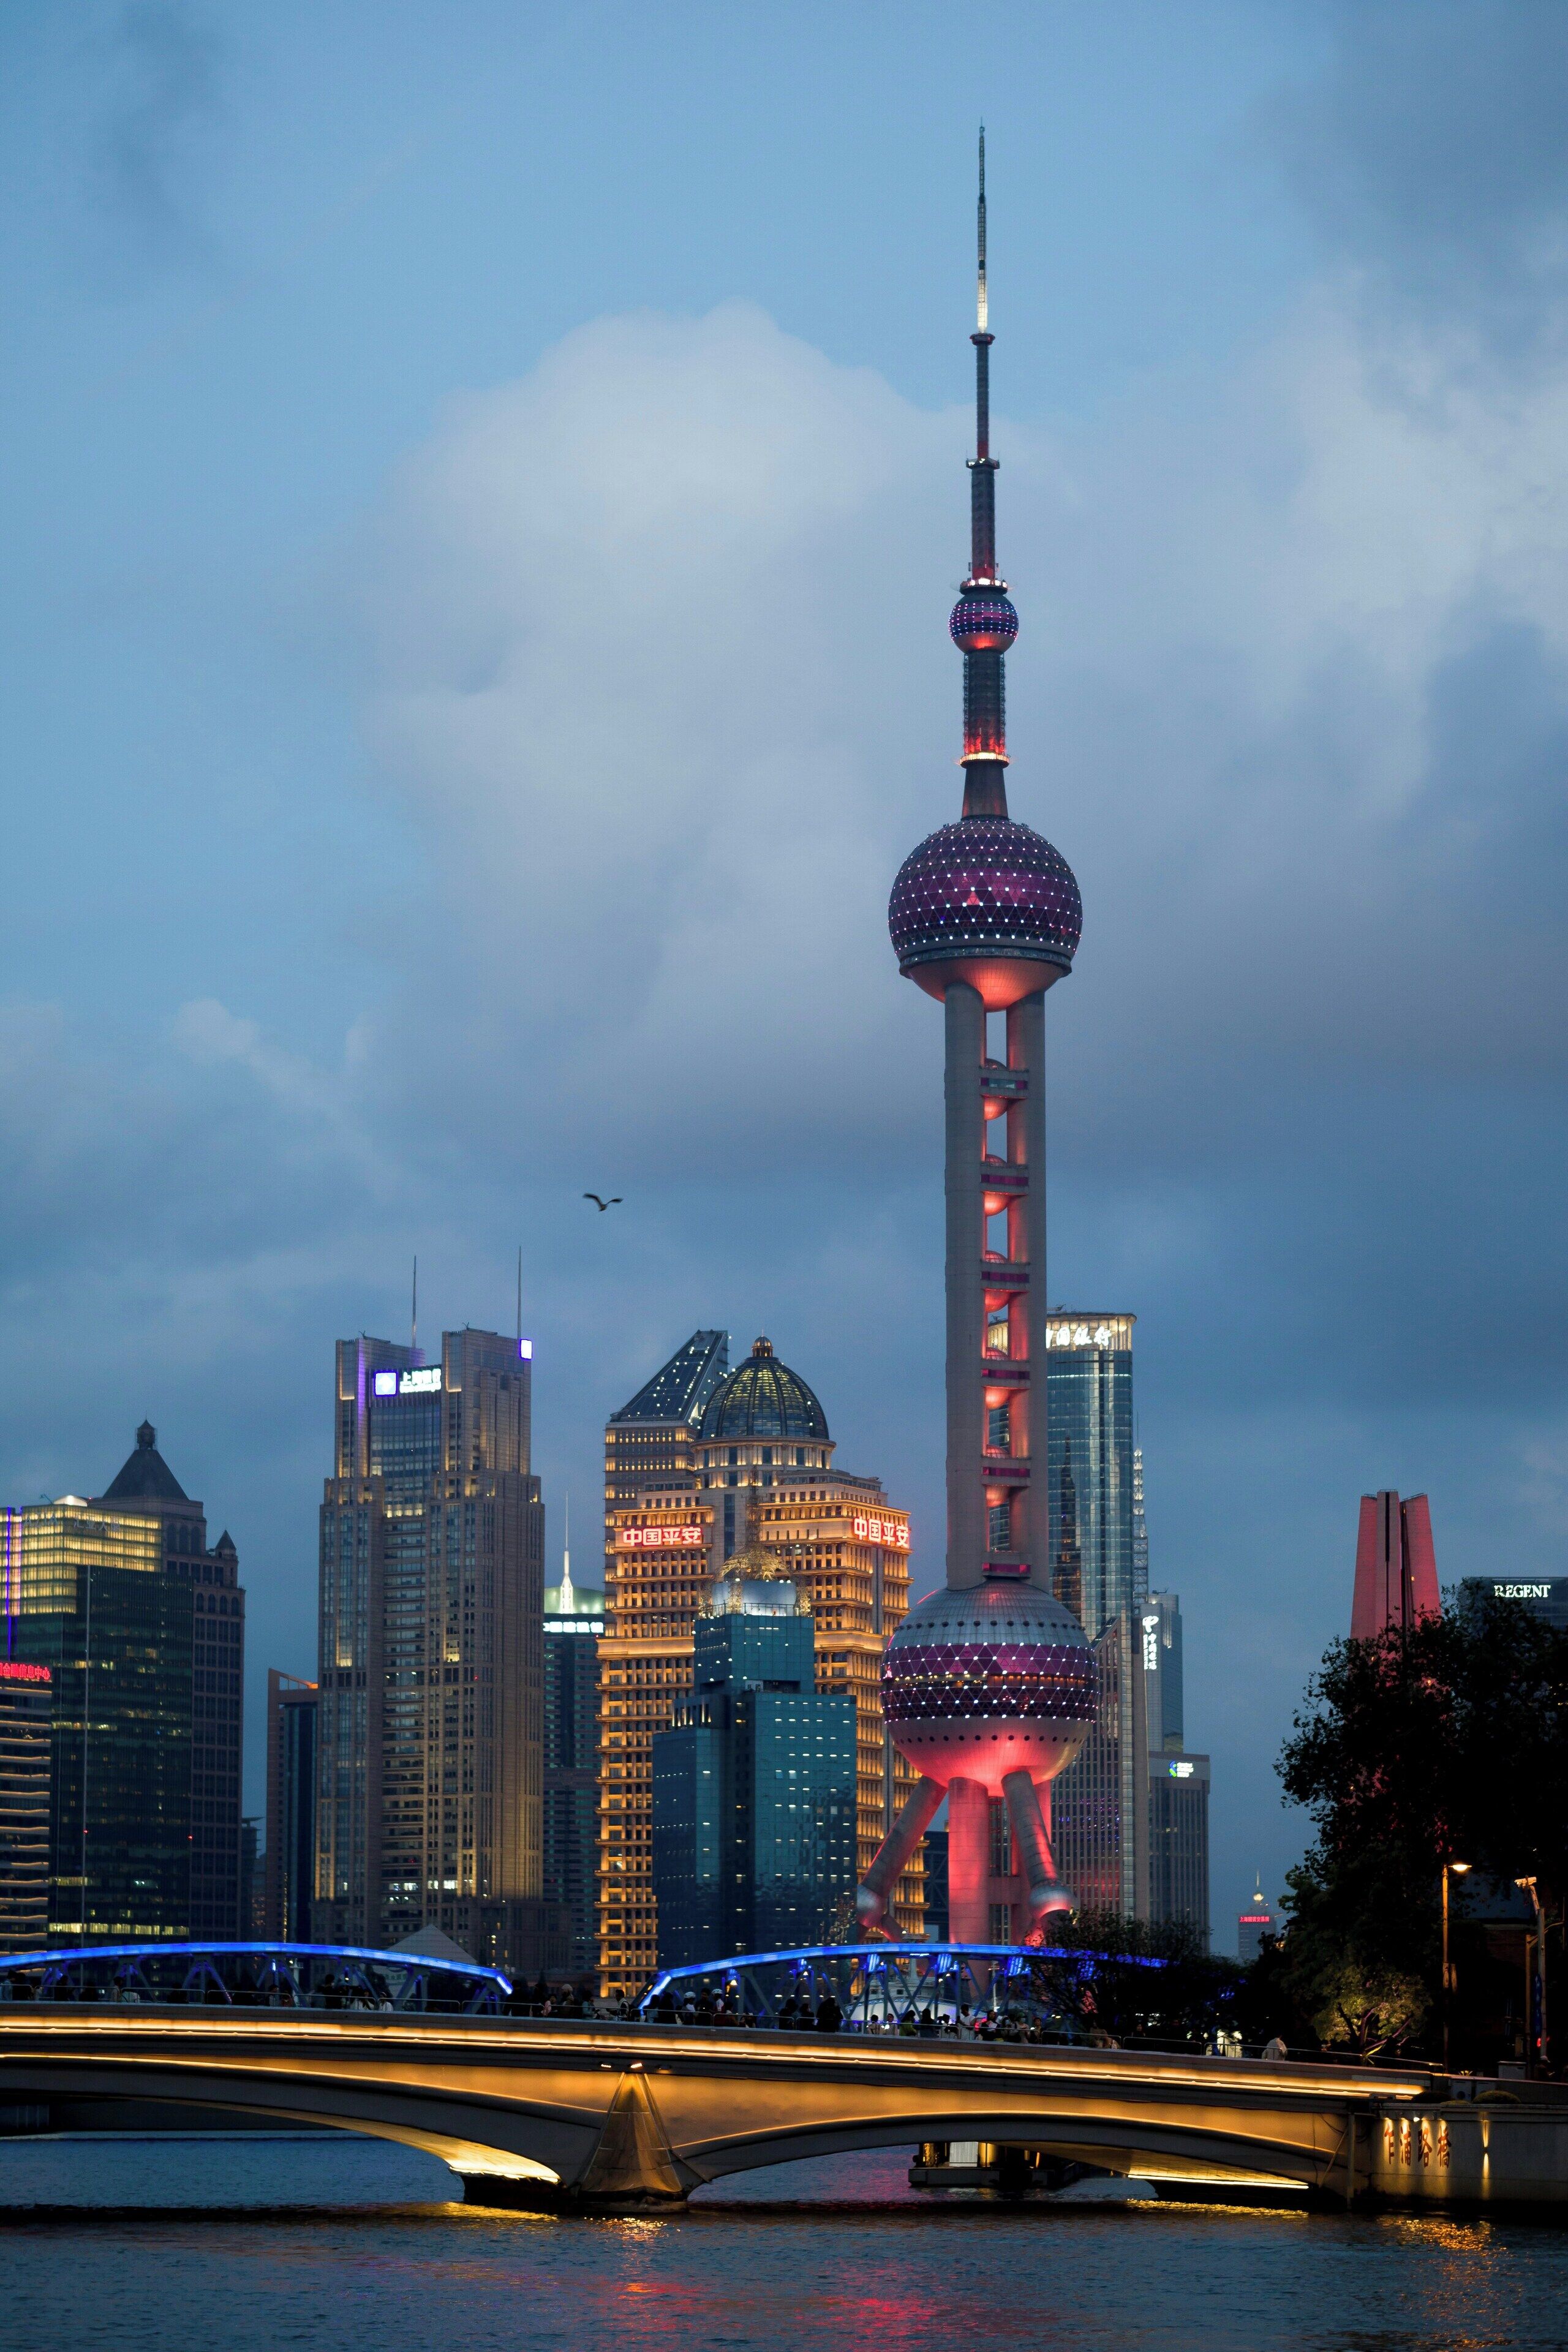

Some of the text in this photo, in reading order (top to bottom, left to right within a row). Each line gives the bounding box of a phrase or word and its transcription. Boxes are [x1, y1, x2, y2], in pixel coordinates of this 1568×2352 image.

[623, 1527, 702, 1547] 中国平安
[854, 1516, 910, 1549] 中国平安
[1493, 1585, 1551, 1598] REGENT
